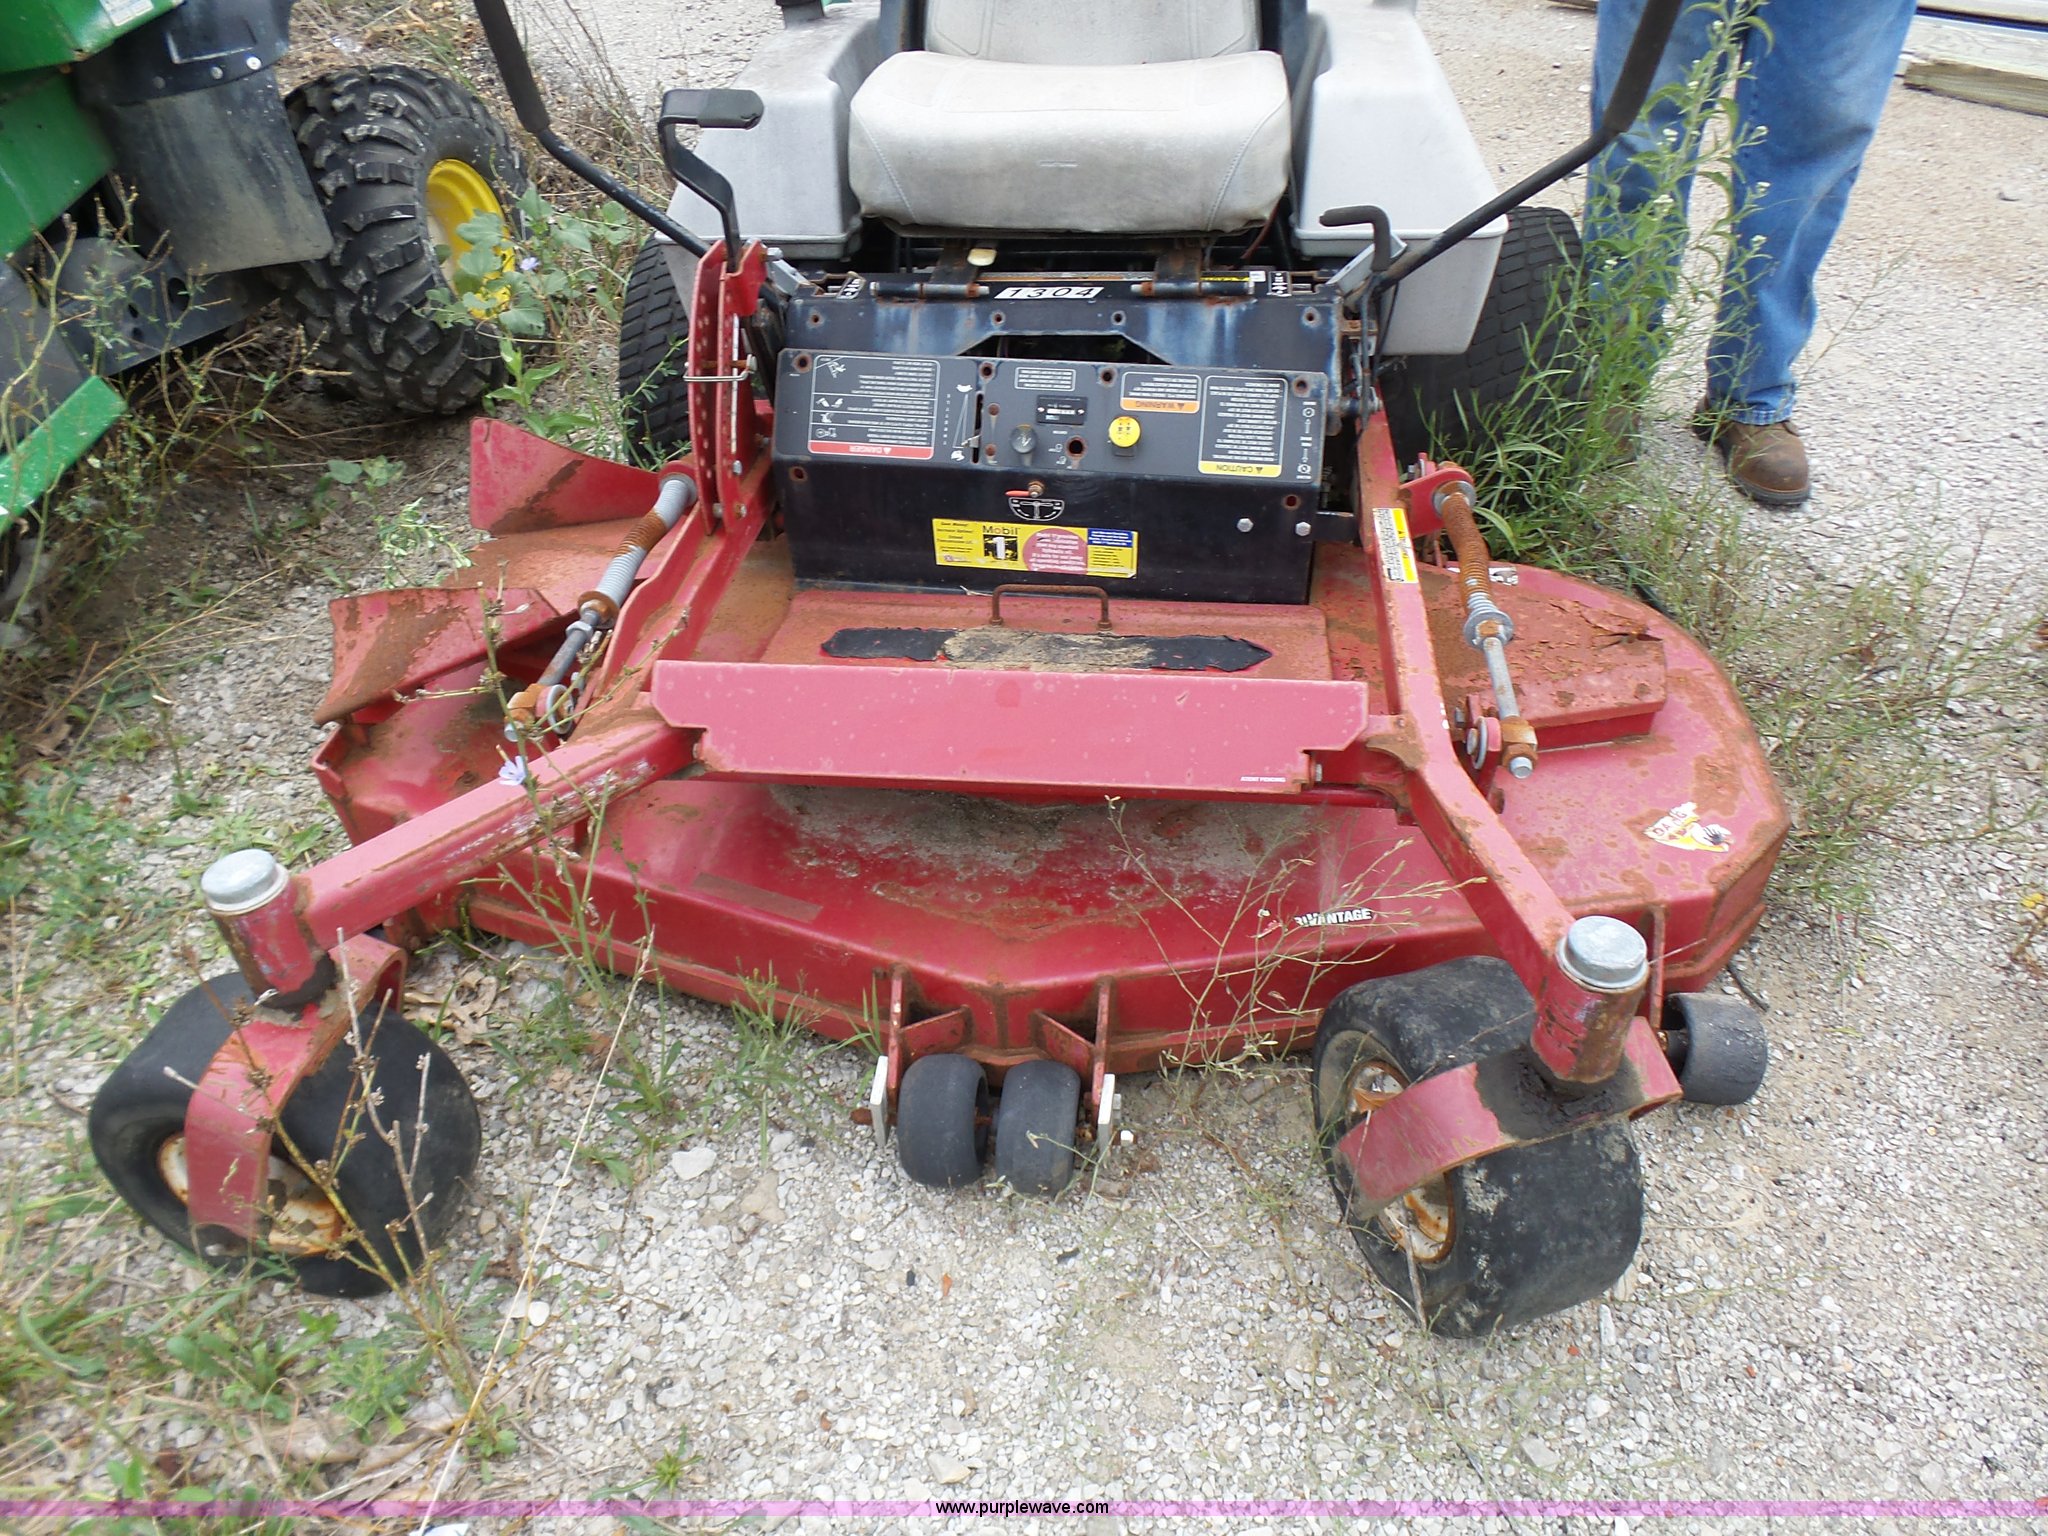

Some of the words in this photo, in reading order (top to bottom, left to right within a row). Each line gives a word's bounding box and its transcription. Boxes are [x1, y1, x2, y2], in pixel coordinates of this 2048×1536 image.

[1008, 287, 1095, 298] 1304
[1216, 464, 1254, 474] CAUTION
[982, 525, 1018, 535] Mobil
[992, 536, 1006, 560] 1
